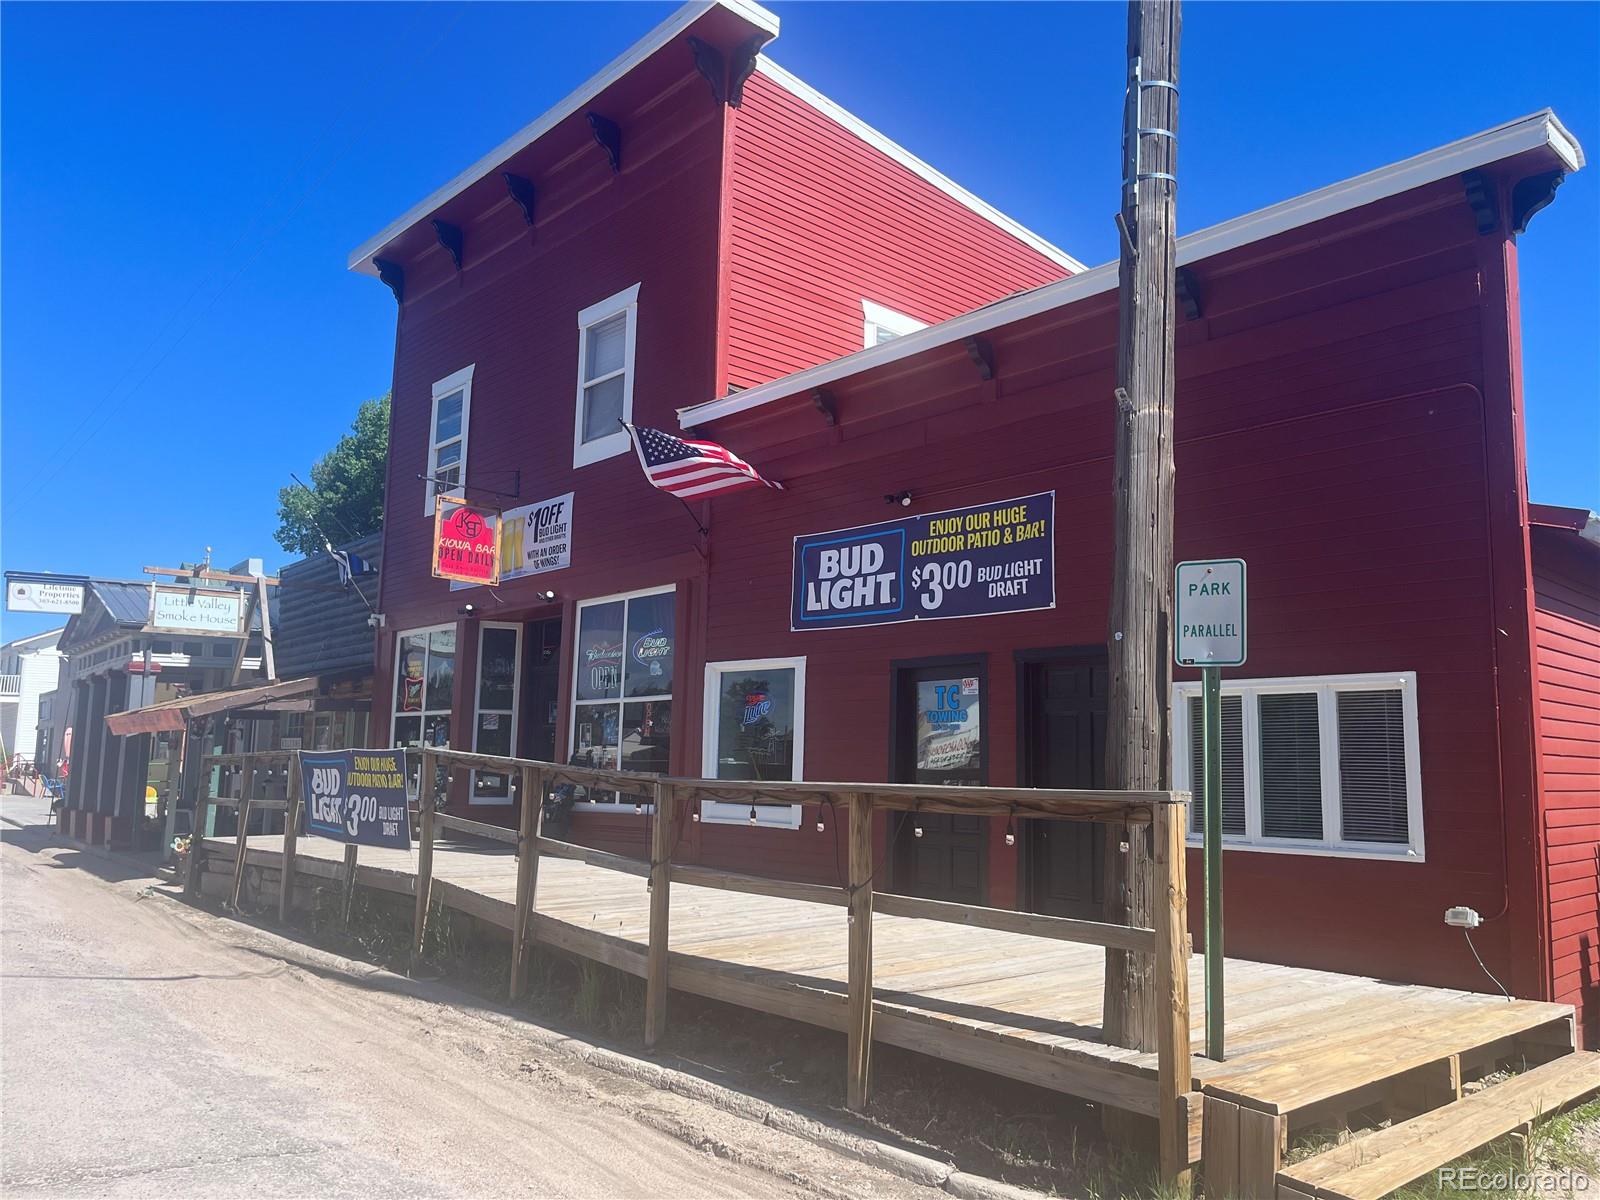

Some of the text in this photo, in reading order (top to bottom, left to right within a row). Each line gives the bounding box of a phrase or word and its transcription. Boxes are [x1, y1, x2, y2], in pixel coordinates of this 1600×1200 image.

[540, 502, 564, 528] OFF
[929, 505, 1028, 537] ENJOY OUR HUGE
[550, 522, 567, 534] LIGHT
[438, 537, 496, 554] KIOWA BAR
[911, 520, 1046, 557] OUTDOOR PATIO & BAR!
[438, 547, 494, 566] OPEN DAILY
[527, 544, 567, 560] WITH AN ORDER
[534, 560, 540, 570] OF
[818, 542, 884, 580] BUD
[976, 565, 1002, 583] BUD
[1004, 558, 1043, 580] LIGHT
[40, 590, 80, 598] Properties
[806, 572, 896, 612] LIGHT
[988, 578, 1028, 599] DRAFT
[1188, 582, 1231, 596] PARK
[197, 597, 231, 614] Valley
[158, 610, 236, 624] Smoke House
[1183, 624, 1238, 638] PARALLEL
[643, 638, 668, 648] BUD
[592, 666, 618, 690] OPEN
[934, 684, 960, 710] TC
[927, 709, 968, 724] TOWING
[354, 756, 370, 771] ENJOY
[312, 768, 340, 796] BUD
[382, 822, 398, 836] DRAFT
